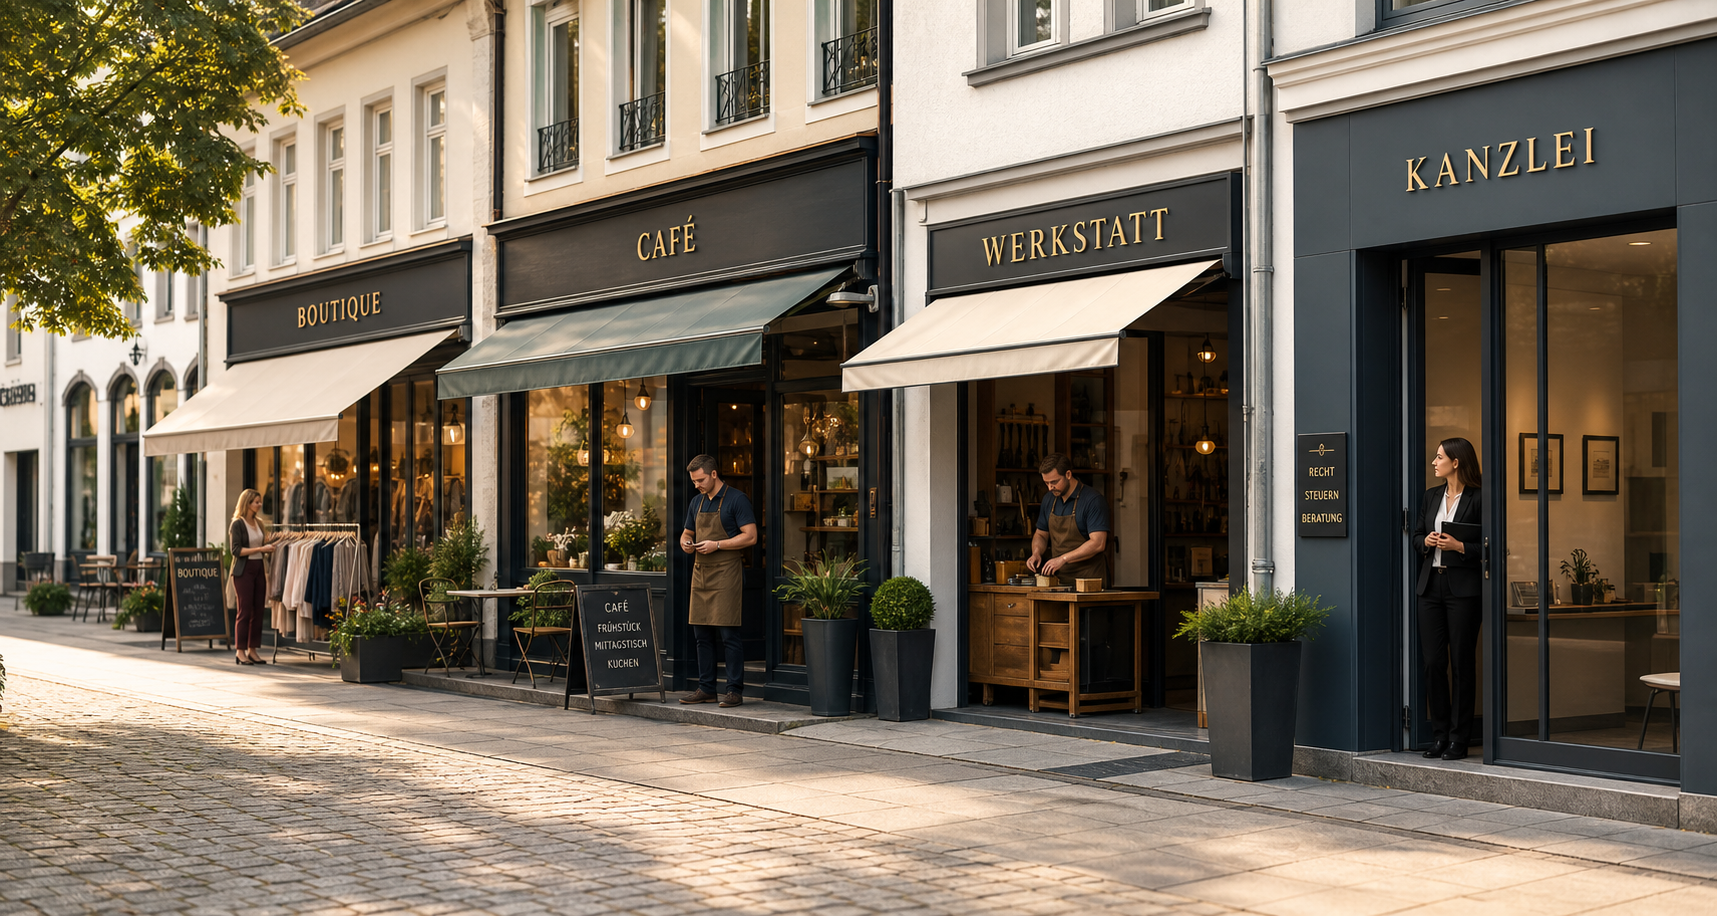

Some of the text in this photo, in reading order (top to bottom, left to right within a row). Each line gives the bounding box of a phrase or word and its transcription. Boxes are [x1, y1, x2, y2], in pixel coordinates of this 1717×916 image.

[1405, 126, 1595, 192] KANZLEI
[637, 214, 696, 261] CAFÉ
[981, 207, 1169, 267] WERKSTATT
[297, 291, 381, 329] BOUTIQUE
[1308, 466, 1335, 477] RECHT
[1304, 490, 1339, 500] STEUERN
[1301, 513, 1343, 523] BERATUNG
[177, 567, 218, 579] BOUTIQUE
[604, 599, 629, 613] CAFÉ
[594, 639, 648, 650] MITTAGSTISCH
[607, 658, 639, 669] KUCHEN
